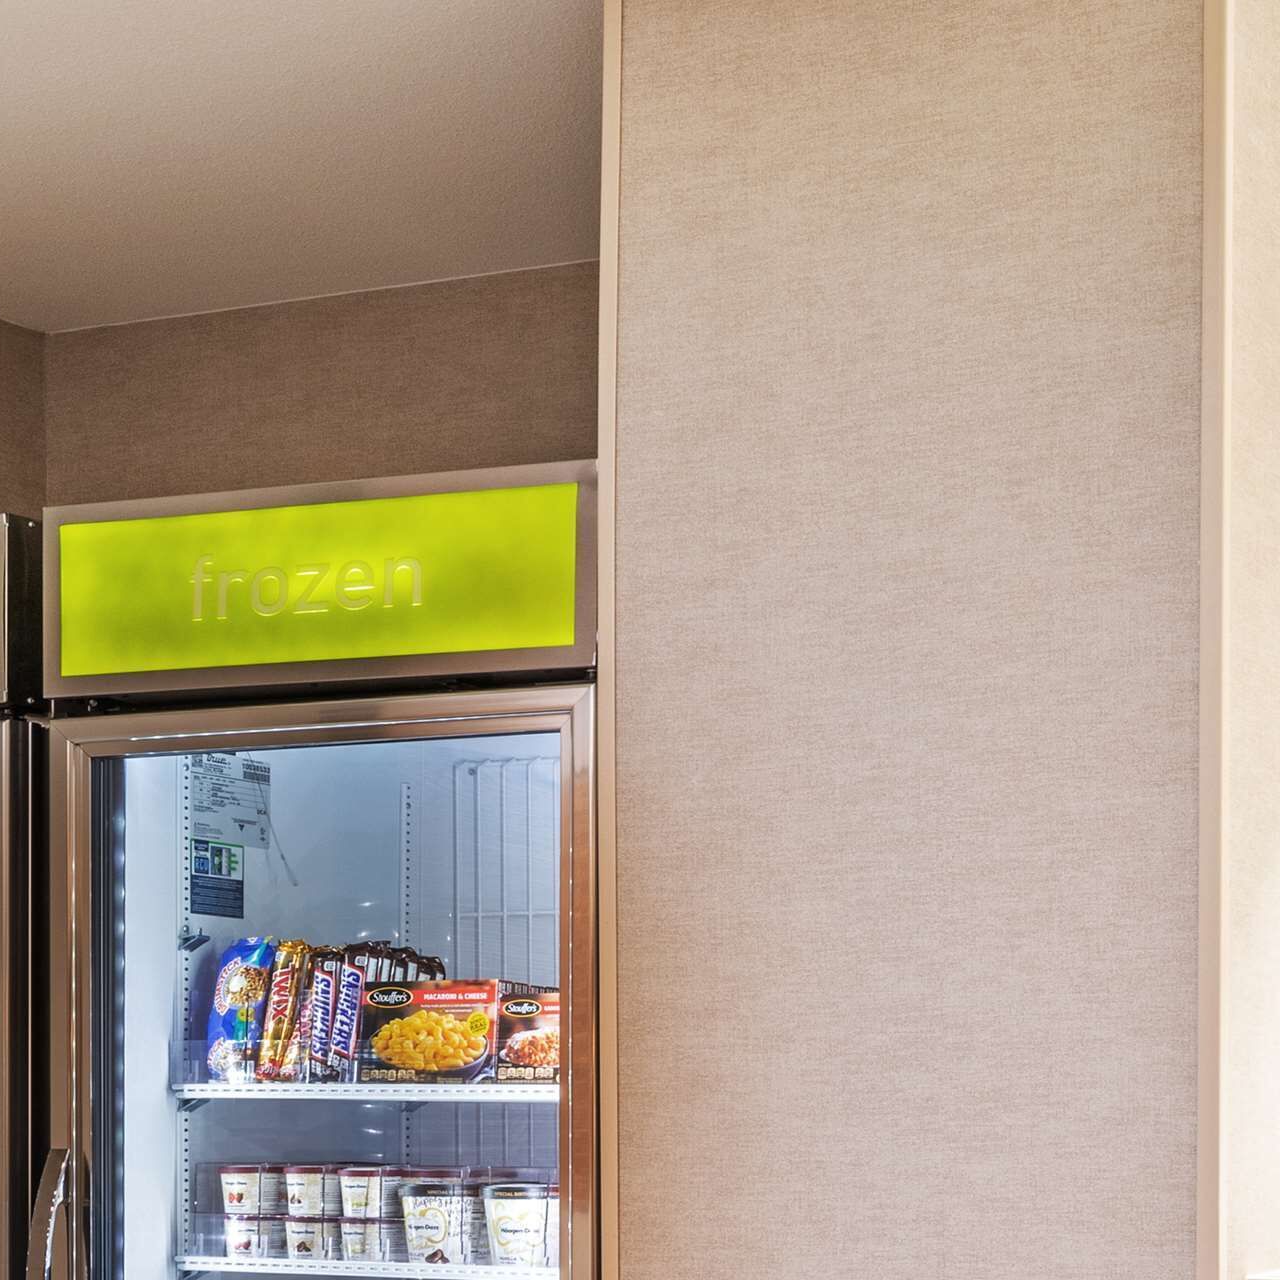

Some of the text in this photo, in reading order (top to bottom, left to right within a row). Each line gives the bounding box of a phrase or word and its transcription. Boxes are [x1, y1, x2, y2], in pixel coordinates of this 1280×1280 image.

[188, 553, 424, 624] frozen
[271, 963, 295, 1023] TWIX
[372, 991, 408, 1004] Stouffer's
[464, 992, 488, 1000] CHEESE
[508, 1004, 537, 1014] Stouffer's
